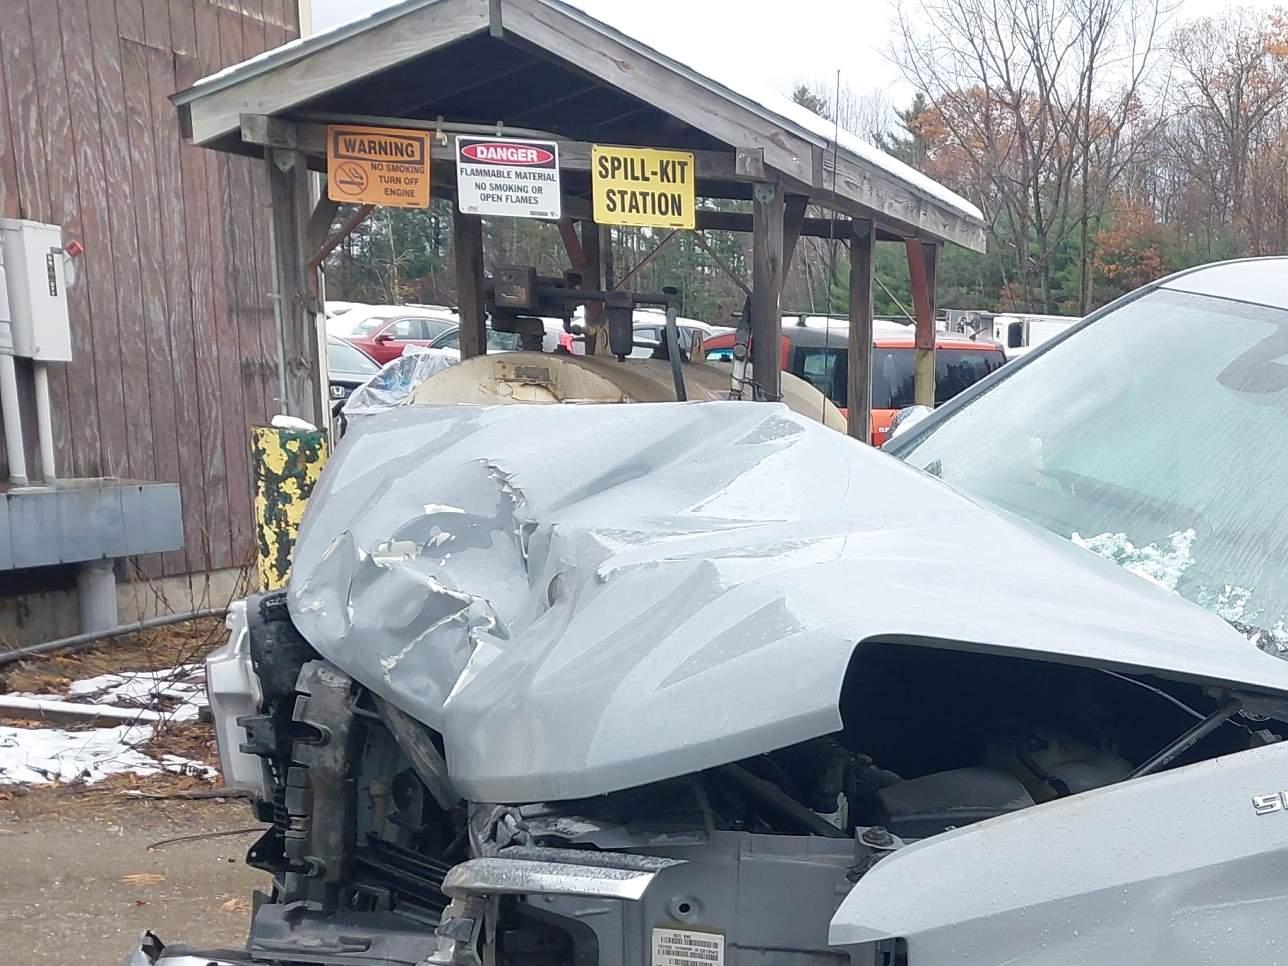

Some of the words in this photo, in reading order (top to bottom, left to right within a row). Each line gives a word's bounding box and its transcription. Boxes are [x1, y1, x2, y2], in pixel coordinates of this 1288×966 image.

[344, 137, 415, 158] WARNING
[476, 146, 538, 162] DANGER
[371, 163, 383, 171] NO
[386, 164, 424, 174] SMOKING
[460, 168, 512, 178] FLAMMABLE
[515, 171, 557, 182] MATERIAL
[598, 155, 688, 184] SPILL-KIT
[378, 175, 401, 185] TURN
[403, 177, 419, 186] OFF
[384, 188, 416, 197] ENGINE
[475, 182, 487, 191] NO
[489, 184, 529, 193] SMOKING
[531, 186, 543, 194] OR
[480, 193, 503, 202] OPEN
[505, 195, 539, 204] FLAMES
[606, 188, 682, 217] STATION
